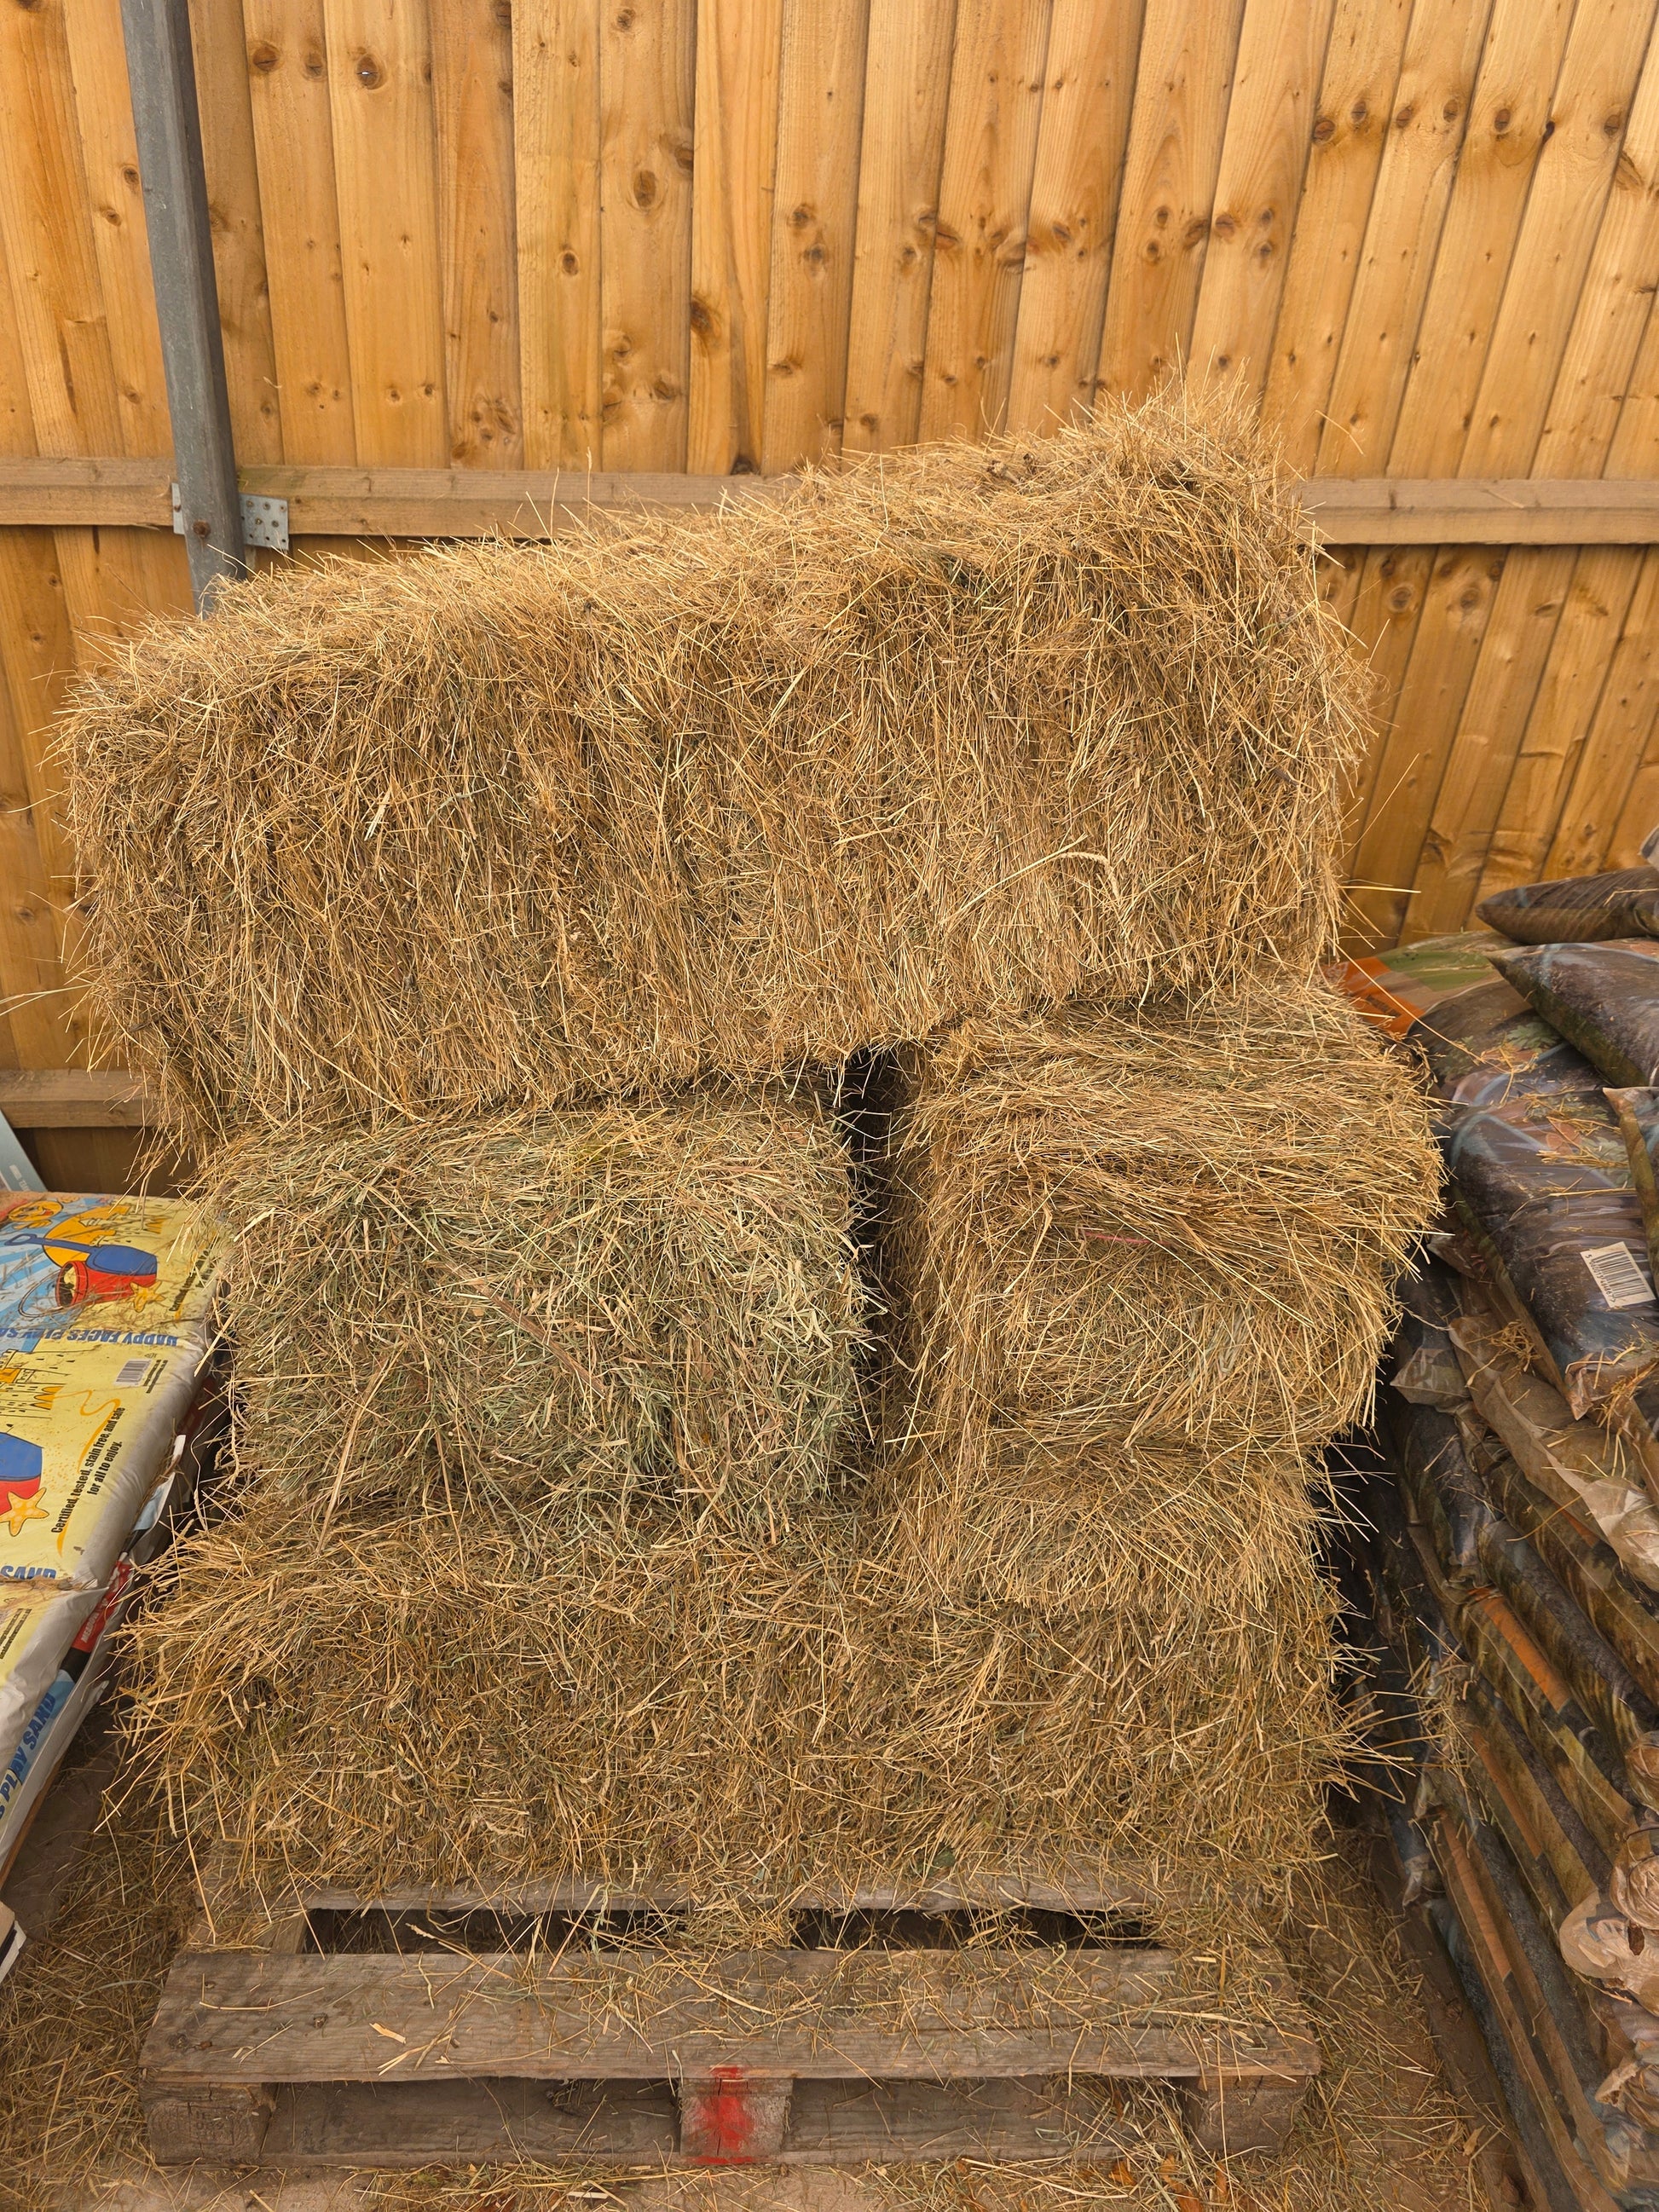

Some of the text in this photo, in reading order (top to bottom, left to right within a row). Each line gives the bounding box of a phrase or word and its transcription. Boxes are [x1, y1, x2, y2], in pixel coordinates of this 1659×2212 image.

[66, 1328, 121, 1343] FACES
[122, 1331, 179, 1347] HAPPY
[51, 1407, 125, 1533] Certified, tested, stain free, and safe
[86, 1441, 123, 1495] for all to enjoy.
[1, 1565, 57, 1580] SAND
[0, 1692, 55, 1803] PLAY SAND
